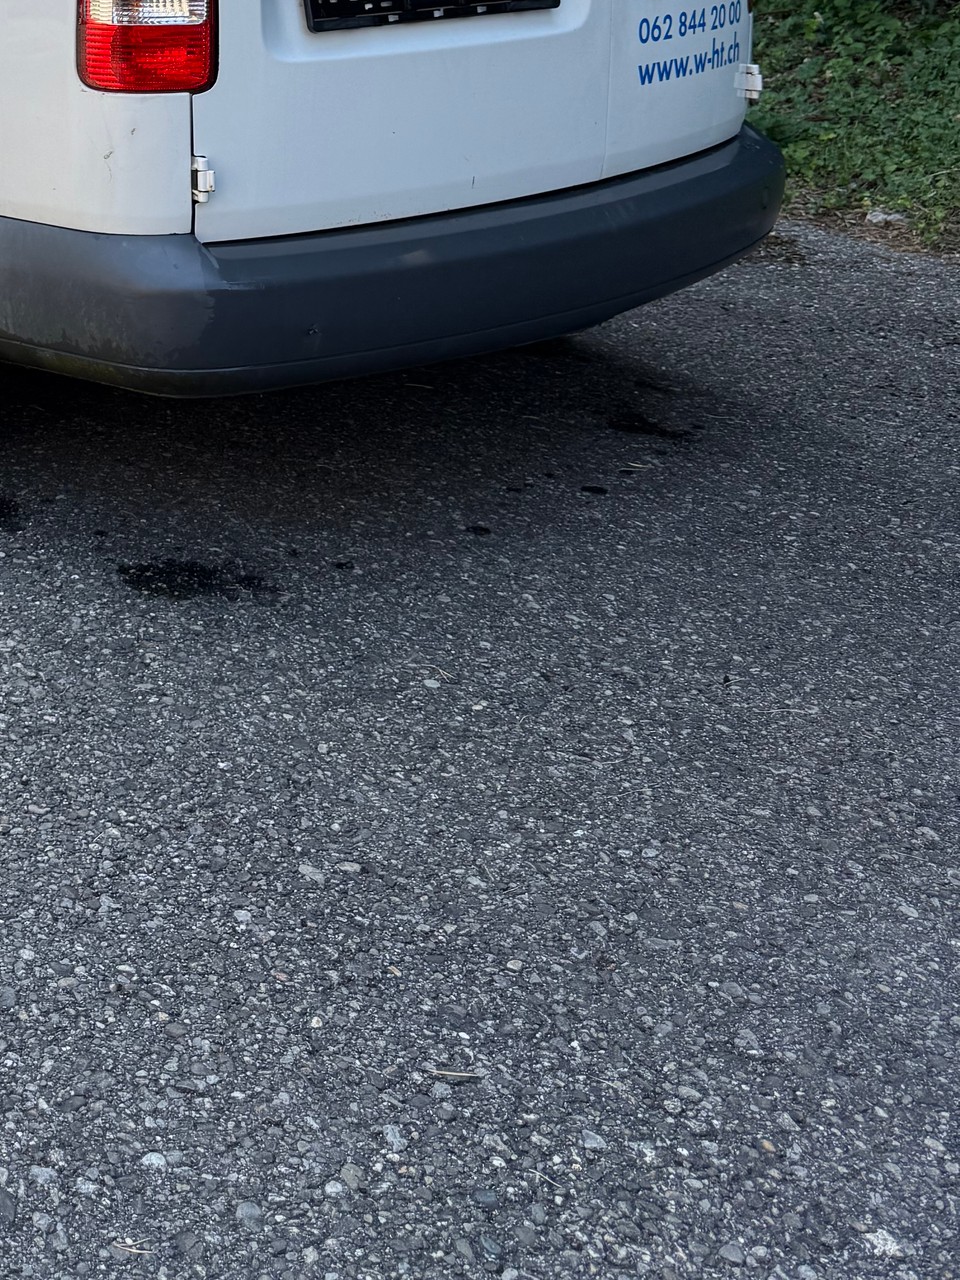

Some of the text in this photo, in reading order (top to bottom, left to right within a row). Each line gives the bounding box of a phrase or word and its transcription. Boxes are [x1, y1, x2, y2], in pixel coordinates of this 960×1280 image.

[638, 0, 741, 44] 062 844 20 00
[638, 31, 740, 86] www.w-ht.ch
